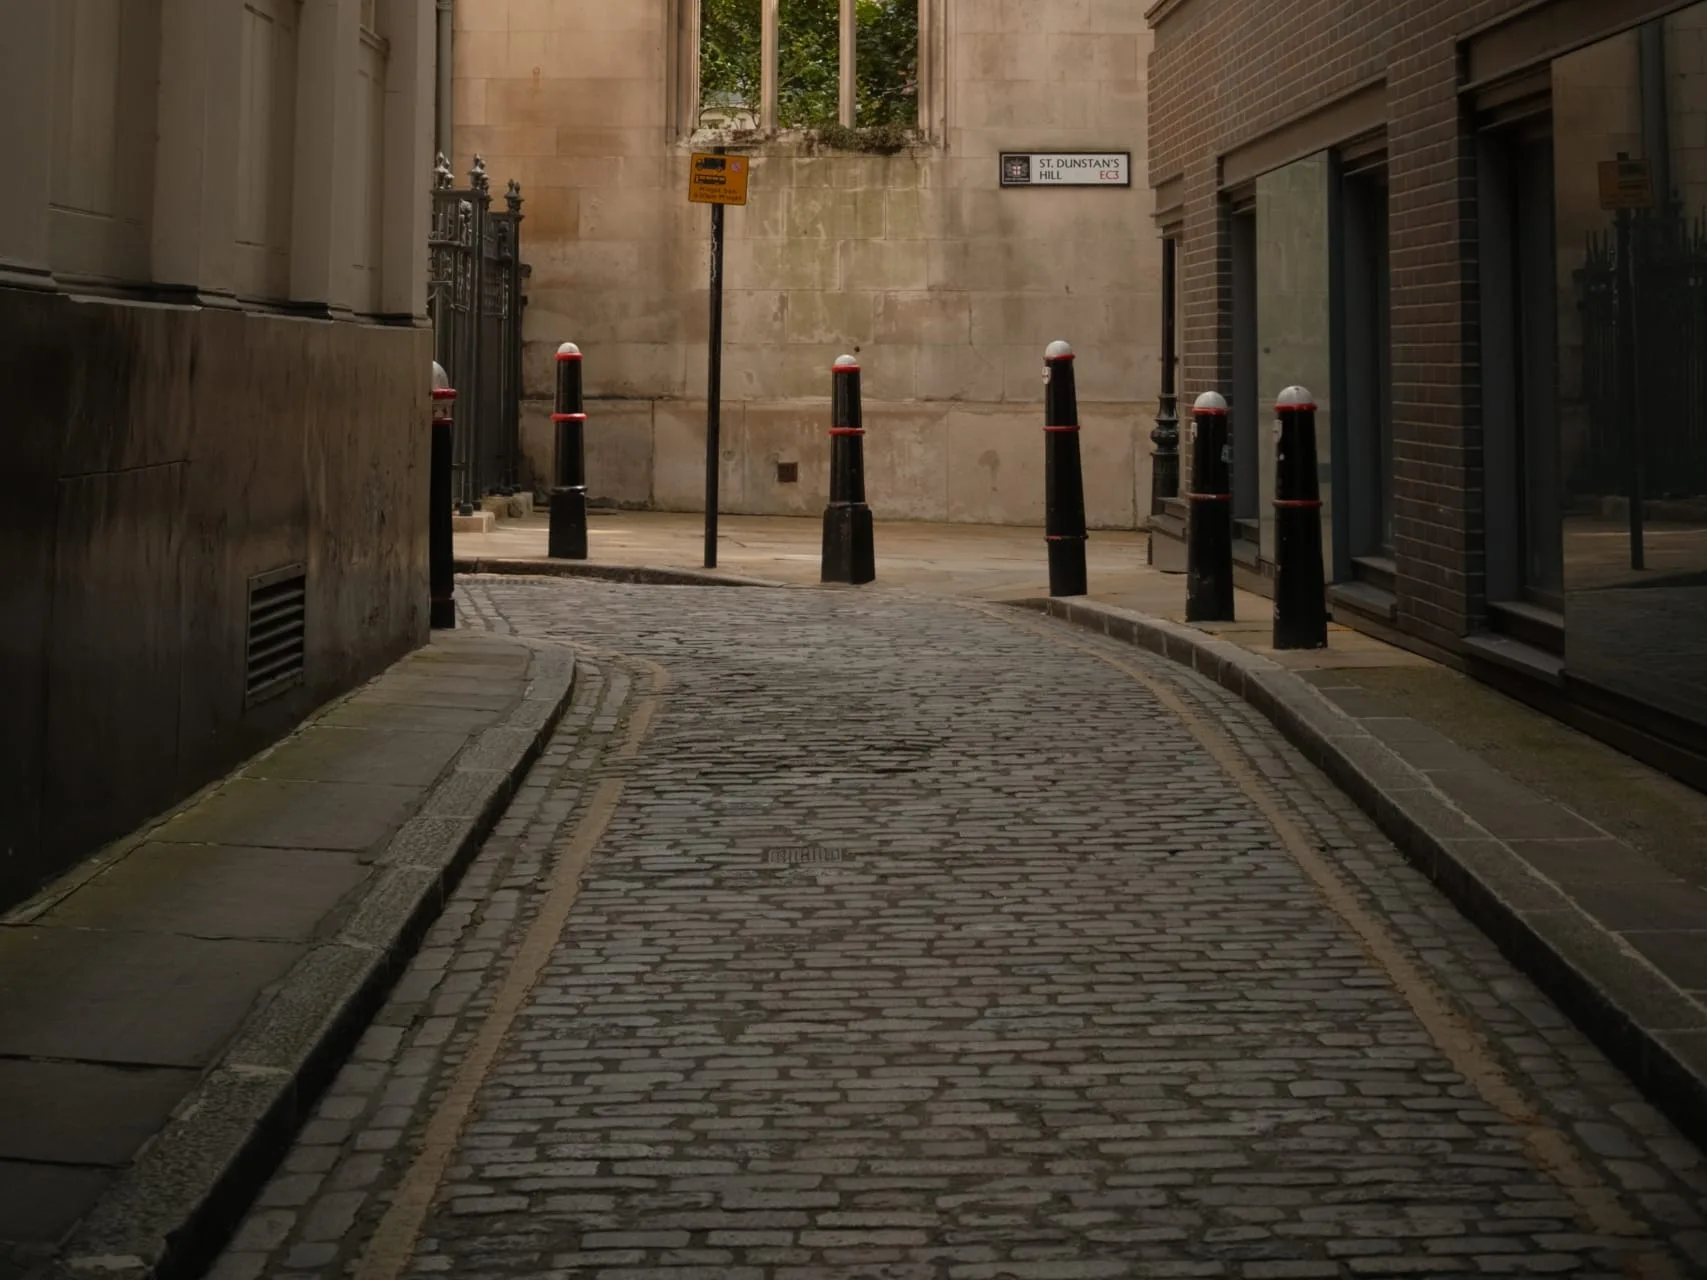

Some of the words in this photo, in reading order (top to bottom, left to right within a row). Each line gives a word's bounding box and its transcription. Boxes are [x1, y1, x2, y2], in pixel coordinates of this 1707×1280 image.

[1039, 158, 1054, 169] ST.
[1056, 158, 1120, 169] DUNSTAN'S
[1039, 170, 1062, 180] HILL
[1099, 170, 1120, 180] EC3
